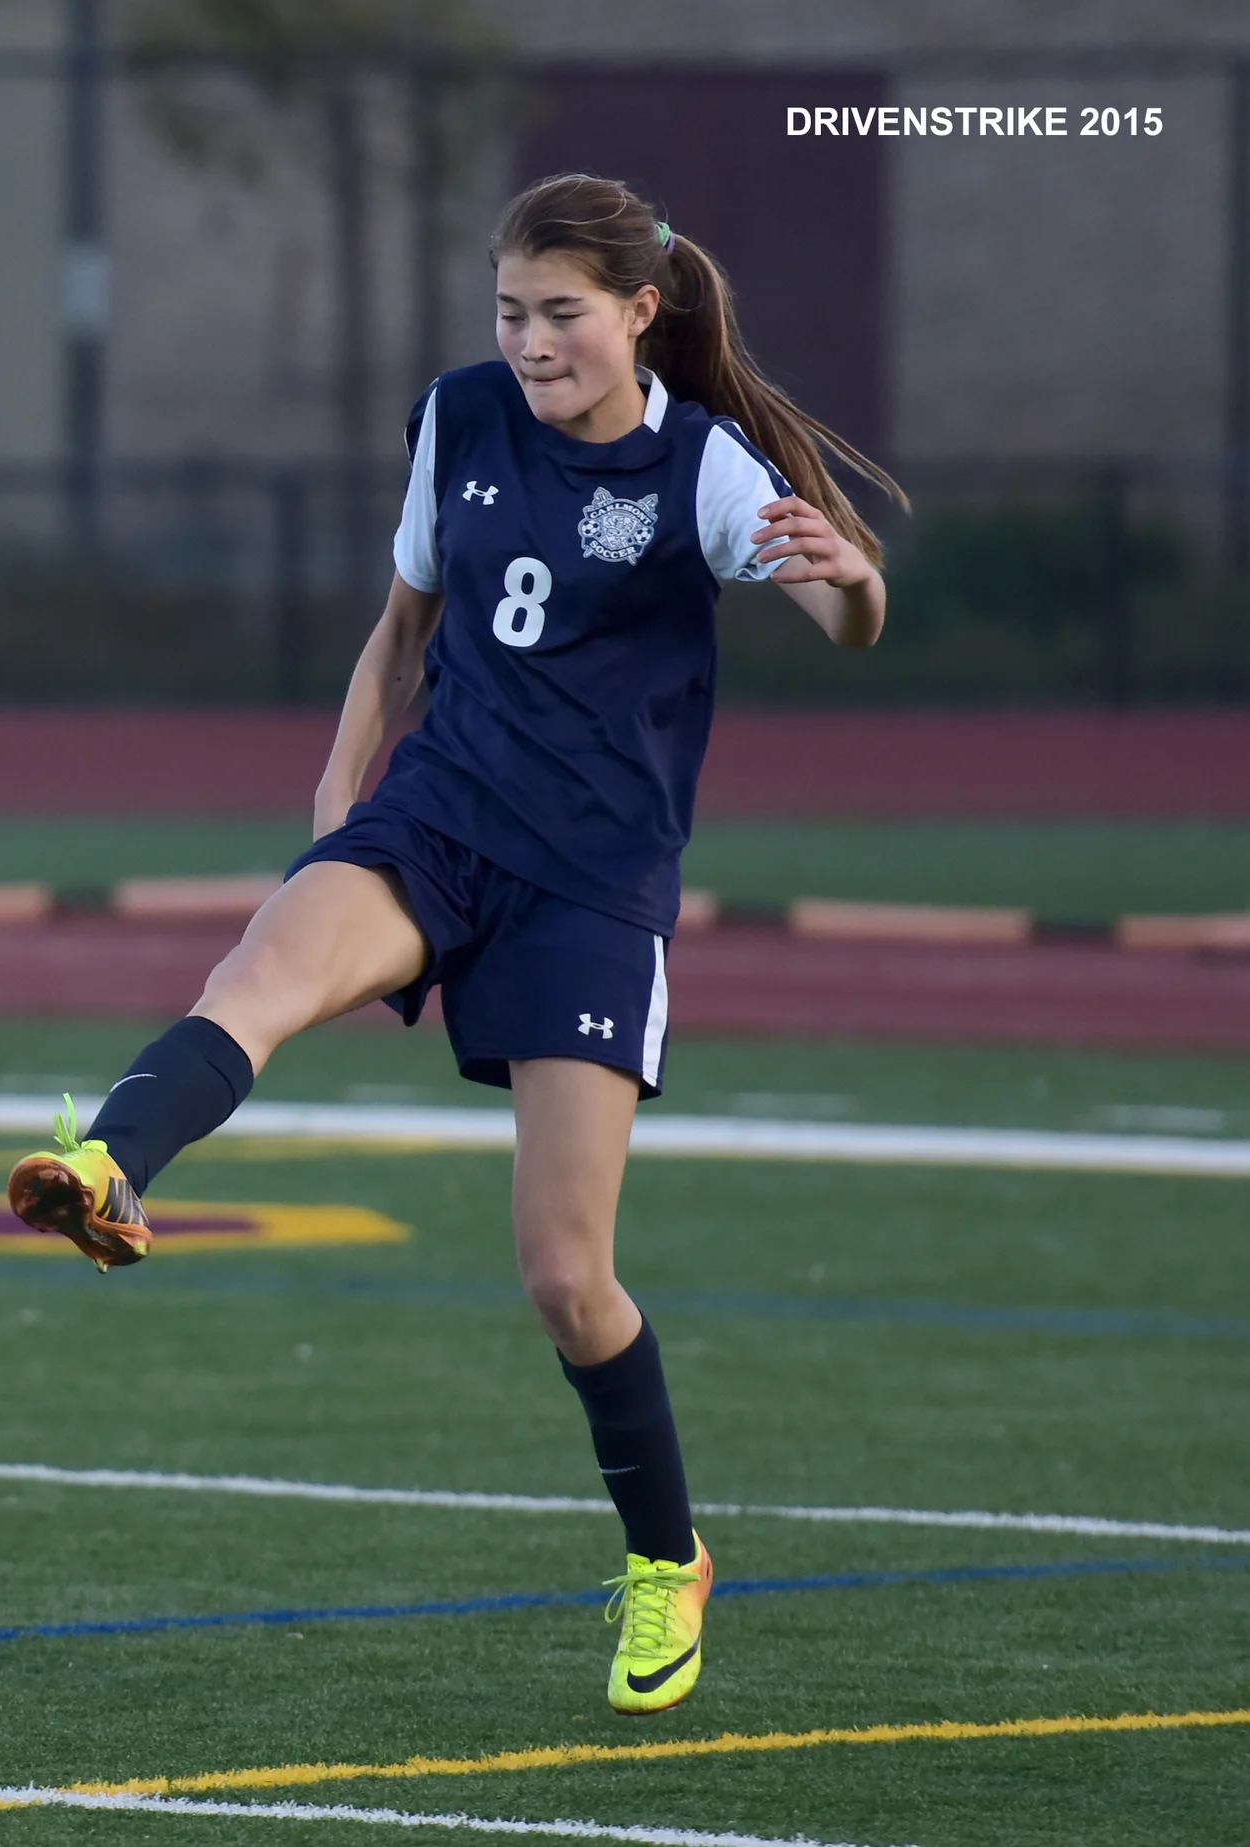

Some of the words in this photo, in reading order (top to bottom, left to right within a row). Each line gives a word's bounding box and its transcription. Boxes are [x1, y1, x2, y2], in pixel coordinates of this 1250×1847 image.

[589, 503, 652, 526] CARLMONT
[589, 540, 636, 559] SOCCER
[492, 556, 552, 647] 8
